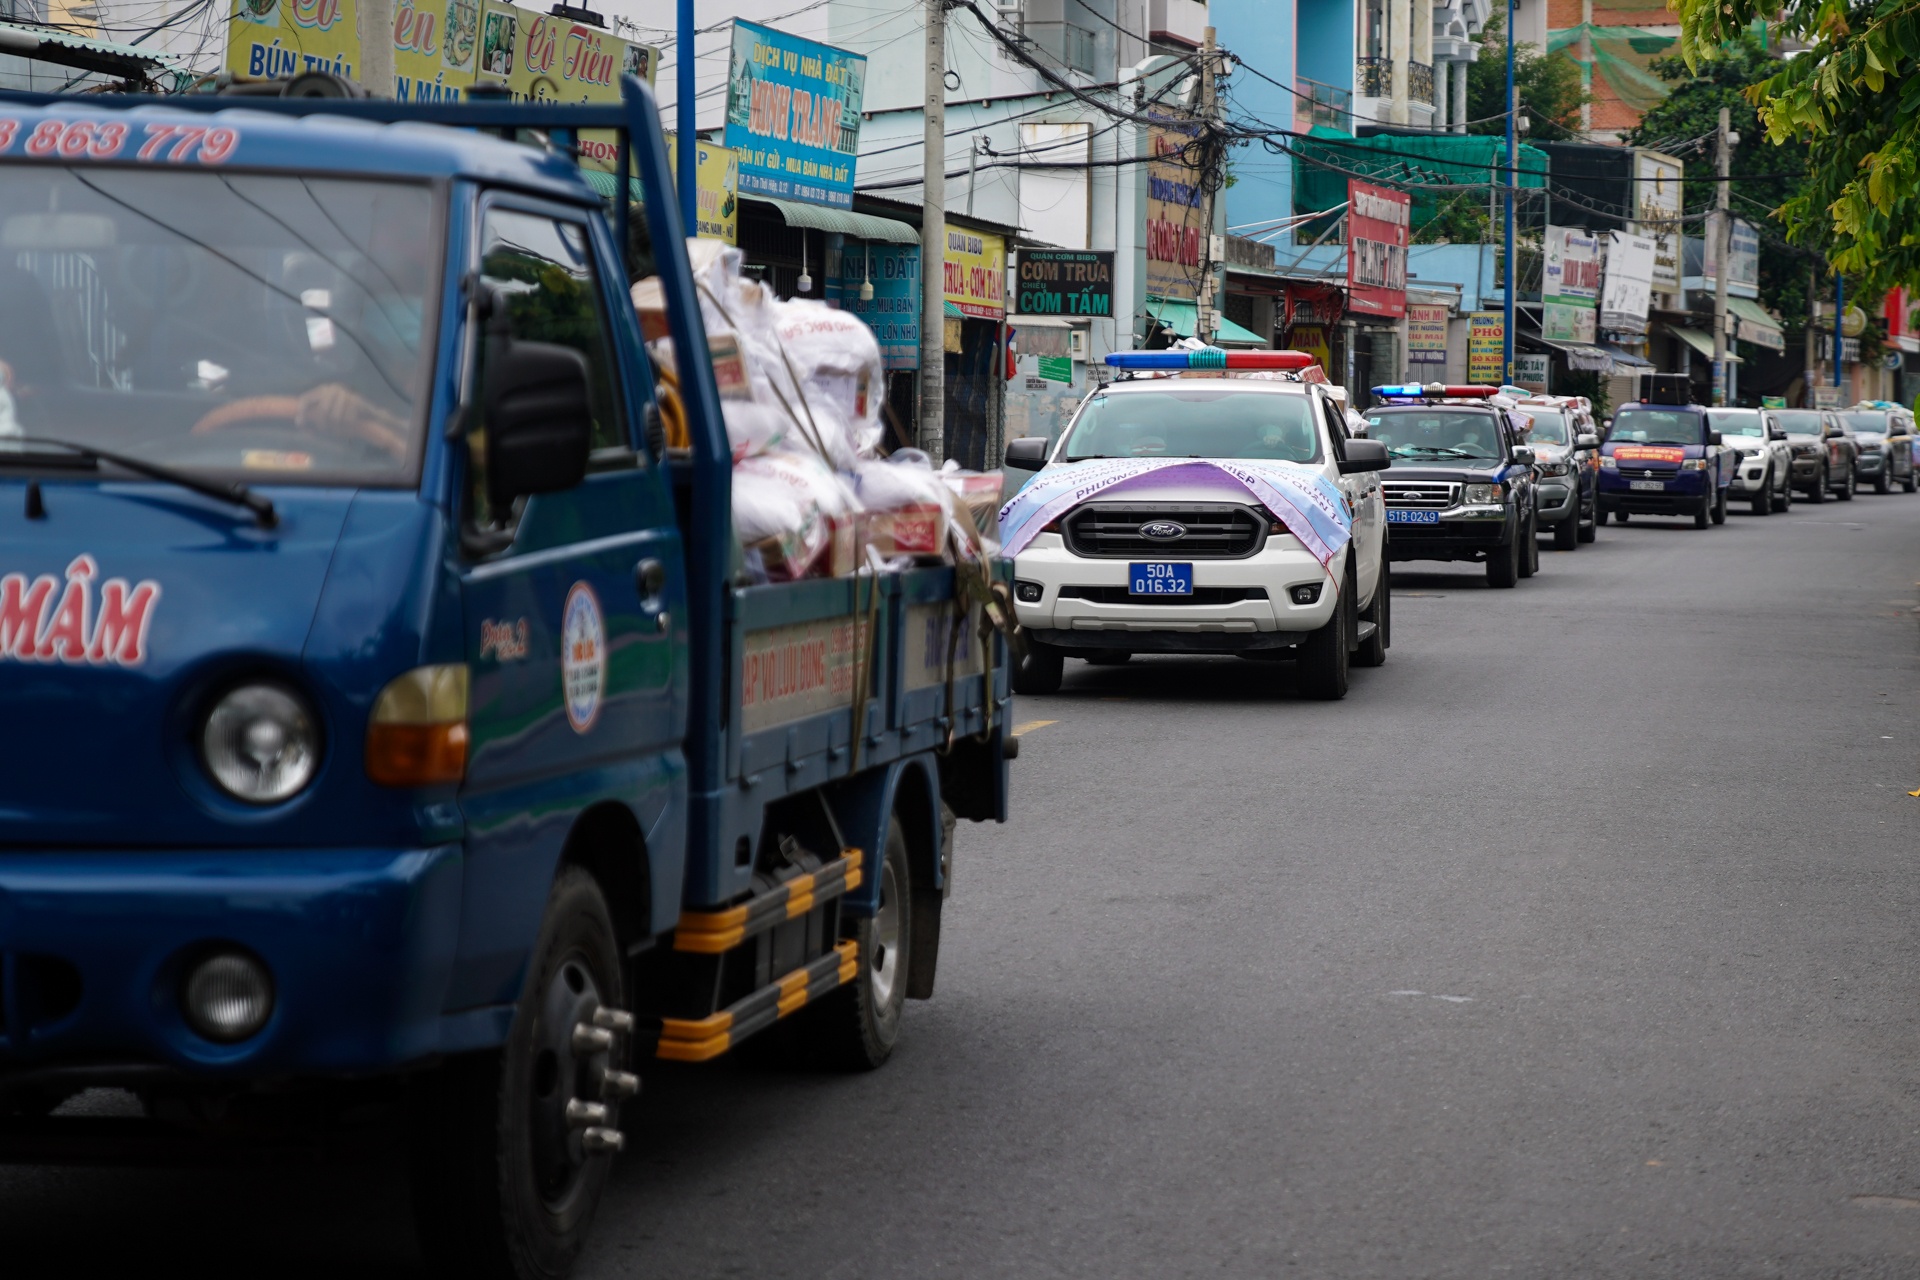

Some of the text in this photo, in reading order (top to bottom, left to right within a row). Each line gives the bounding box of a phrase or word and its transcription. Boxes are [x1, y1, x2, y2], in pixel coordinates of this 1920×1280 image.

[249, 38, 297, 80] BÚN
[563, 25, 614, 87] Tiên
[753, 41, 847, 86] DỊCH VỤ NHÀ ĐẤT
[747, 77, 843, 152] MINH TRANG
[24, 119, 131, 160] 863
[136, 122, 241, 165] 779
[754, 148, 765, 167] KÝ
[767, 148, 781, 170] GỬI
[786, 157, 801, 174] MUA
[803, 158, 818, 177] BÁN
[819, 162, 833, 181] NHÀ
[834, 163, 849, 183] ĐẤT
[948, 231, 983, 255] QUÁN BIBO
[1030, 252, 1054, 260] QUÁN
[1055, 252, 1074, 260] CƠM
[844, 248, 918, 279] NHÀ ĐẤT
[1021, 259, 1109, 282] CƠM TRƯA
[944, 258, 964, 296] TRƯA
[970, 262, 986, 299] CƠM
[986, 256, 1003, 301] TẤM
[877, 296, 894, 314] MUA
[896, 293, 913, 314] BÁN
[1020, 285, 1109, 315] CƠM TẤM
[882, 319, 898, 341] LỚN
[900, 318, 917, 341] NHỎ
[1472, 325, 1503, 337] PHỞ
[1150, 524, 1174, 536] Ford
[1388, 510, 1437, 523] 51B-0249
[1146, 564, 1174, 578] 50A
[1135, 579, 1186, 593] 016.32
[0, 552, 163, 667] MÂM
